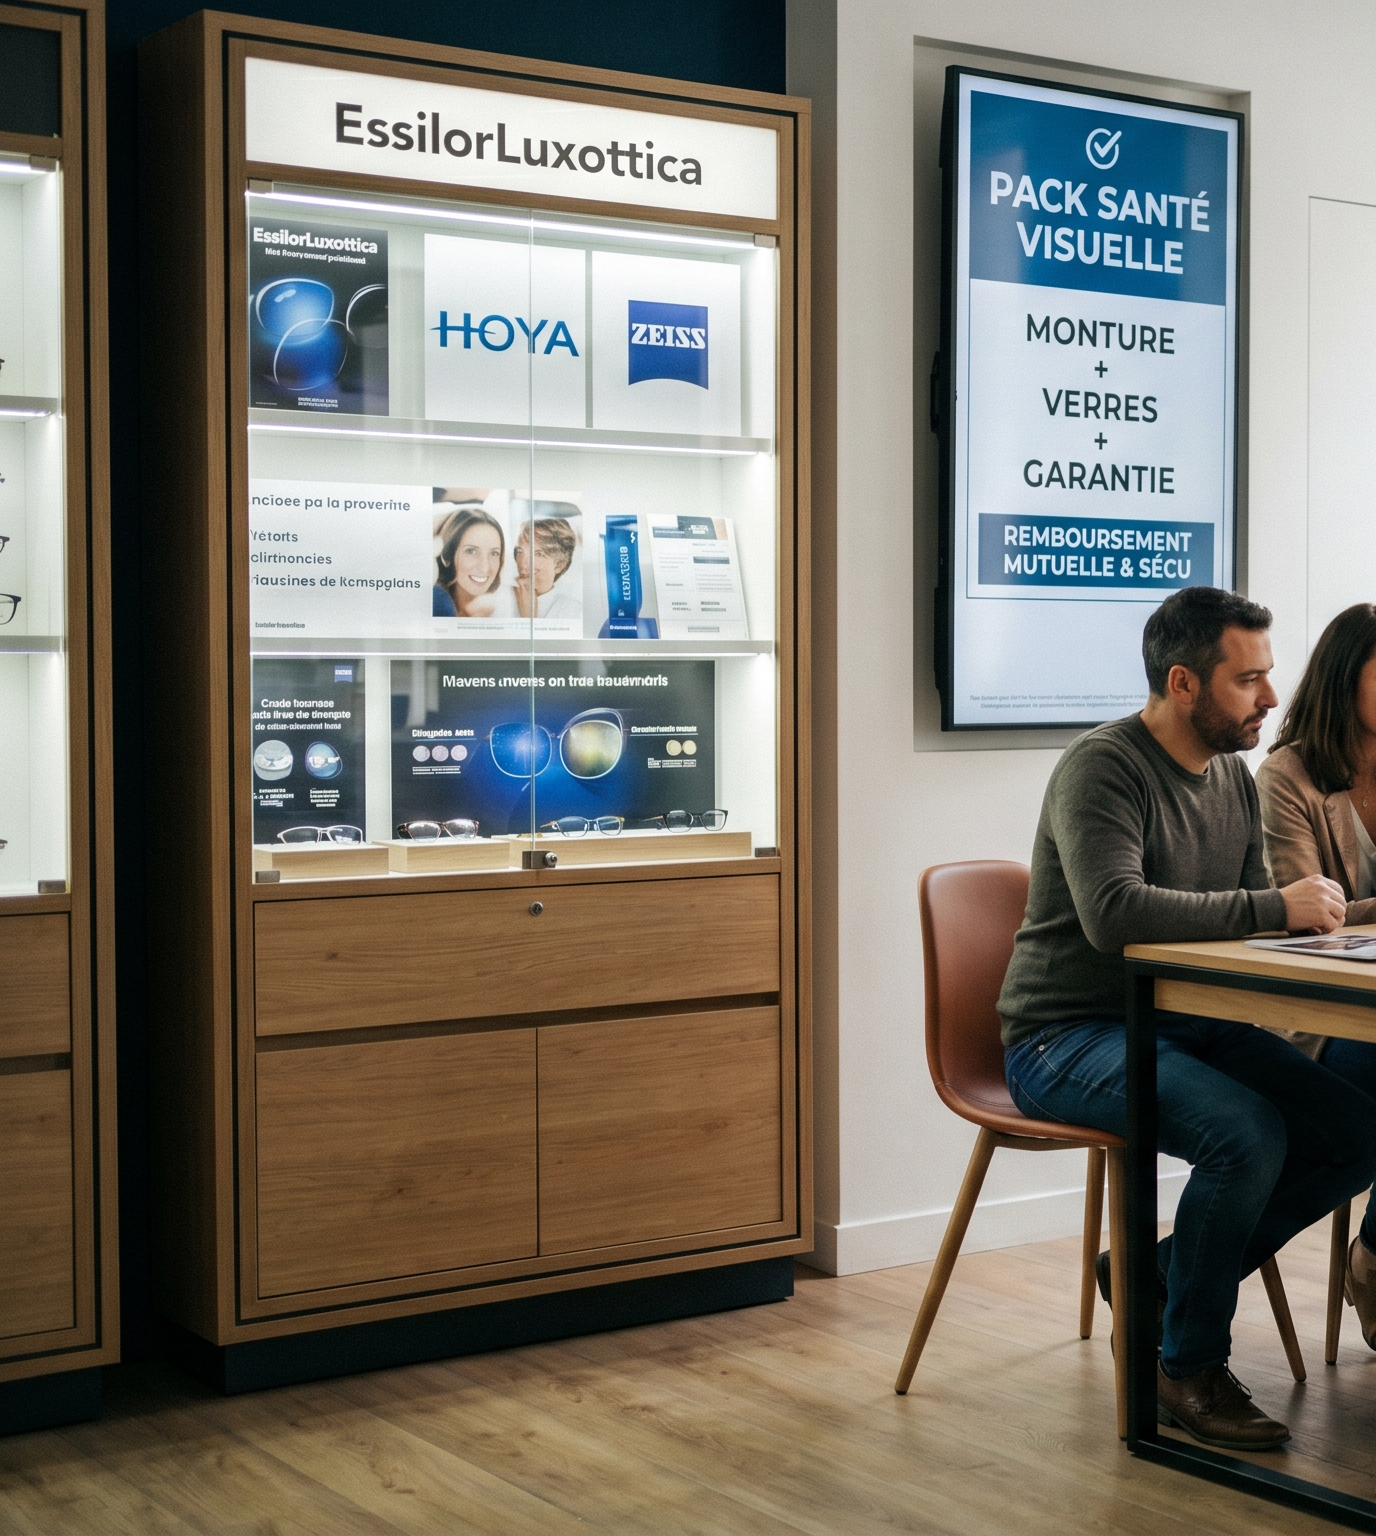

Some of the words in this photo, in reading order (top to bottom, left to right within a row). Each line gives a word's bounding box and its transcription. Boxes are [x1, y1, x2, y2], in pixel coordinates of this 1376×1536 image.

[335, 101, 703, 186] EssilorLuxottica
[990, 170, 1088, 217] PACK
[1097, 185, 1210, 232] SANTÉ
[253, 227, 378, 254] EssilorLuxottica
[1016, 221, 1184, 275] VISUELLE
[430, 310, 580, 358] HOYA
[631, 322, 706, 350] ZEISS
[1026, 313, 1175, 355] MONTURE
[1042, 387, 1159, 424] VERRES
[1023, 459, 1175, 494] GARANTIE
[1004, 525, 1192, 552] REMBOURSEMENT
[319, 576, 337, 587] de
[1004, 553, 1115, 578] MUTUELLE
[1119, 556, 1134, 577] &
[1139, 553, 1192, 579] SÉCU
[549, 677, 566, 687] on
